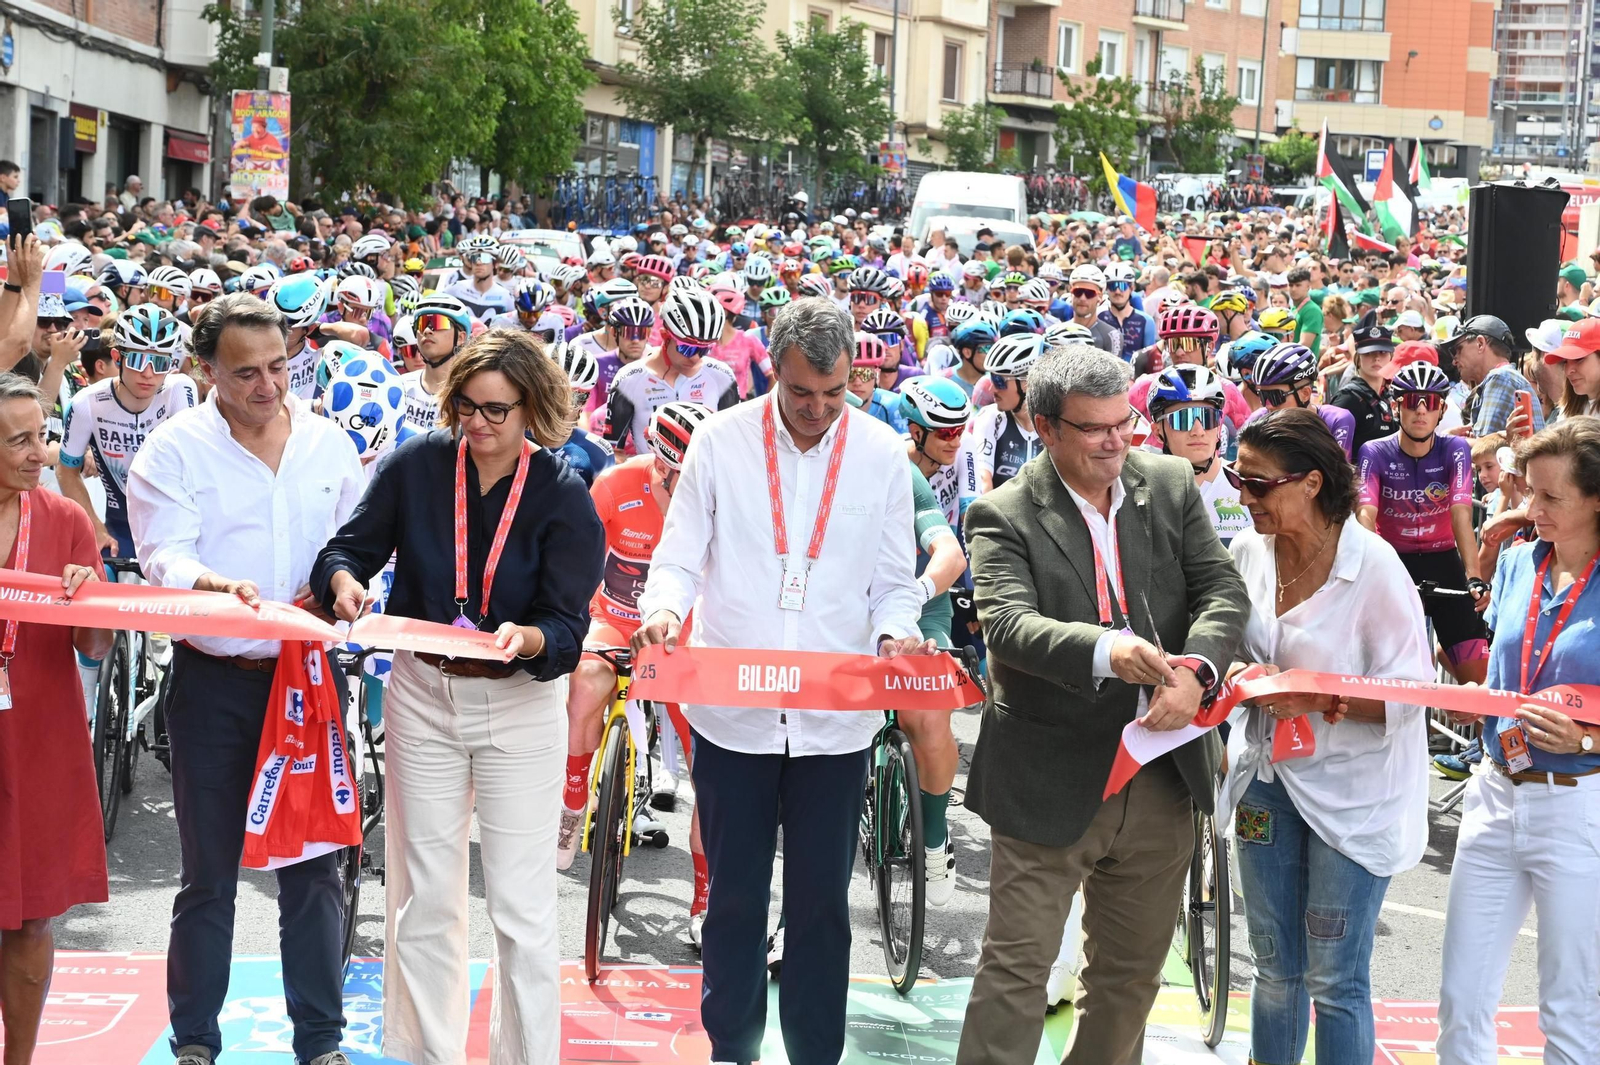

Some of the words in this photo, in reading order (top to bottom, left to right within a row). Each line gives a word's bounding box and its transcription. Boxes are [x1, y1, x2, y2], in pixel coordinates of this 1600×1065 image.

[349, 414, 377, 430] G42
[98, 427, 146, 445] BAHR
[101, 441, 139, 452] VICTO
[1009, 454, 1025, 464] UBS
[965, 451, 976, 492] MERIDA
[621, 528, 654, 541] Santini
[0, 586, 53, 604] VUELTA
[54, 596, 73, 606] 25
[118, 600, 137, 612] LA
[137, 602, 191, 617] VUELTA
[640, 664, 657, 679] 25
[738, 664, 801, 693] BILBAO
[885, 675, 902, 690] LA
[903, 675, 955, 691] VUELTA
[955, 670, 968, 687] 25
[1566, 693, 1583, 709] 25
[251, 756, 286, 825] Carrefou
[866, 1051, 952, 1062] SKODA
